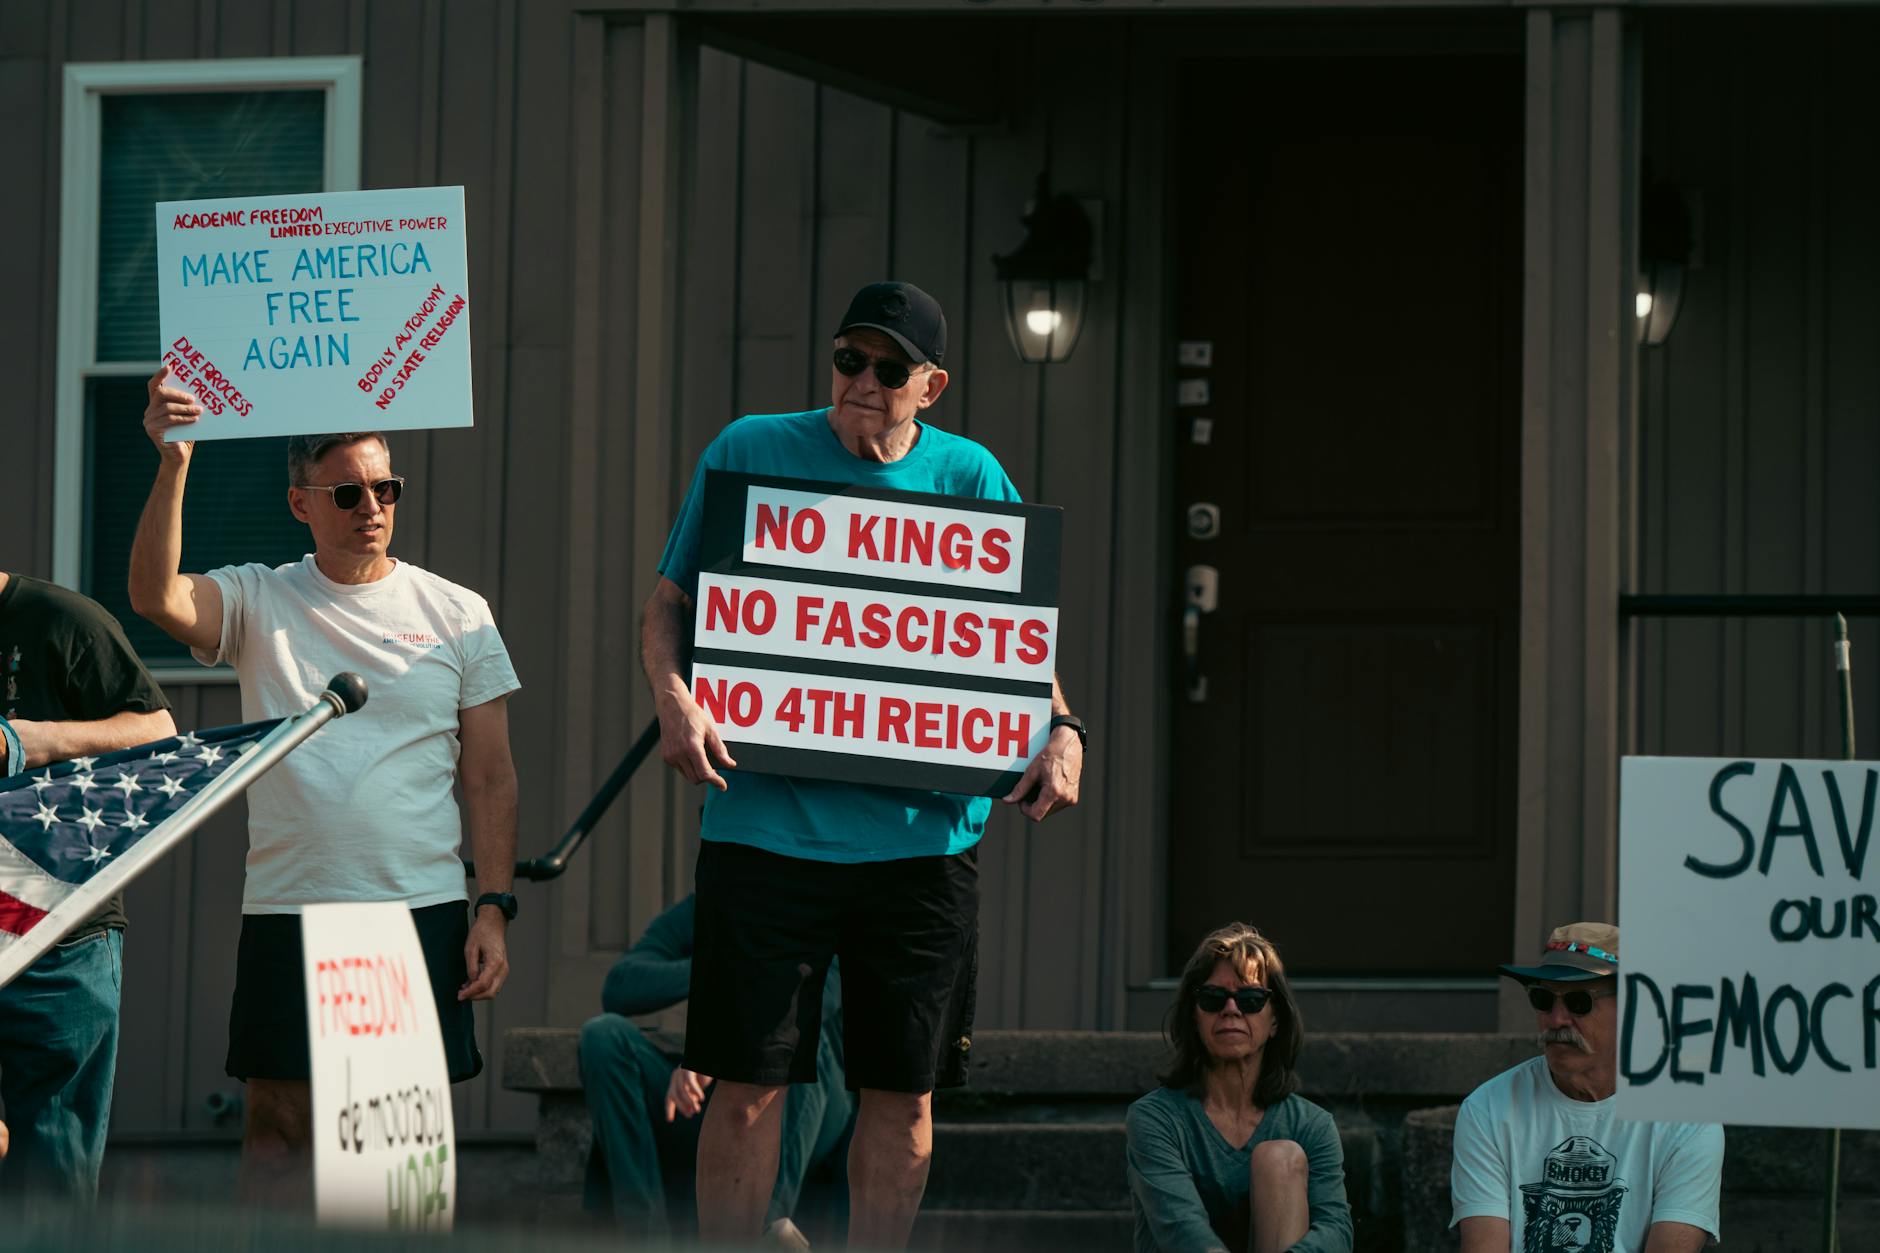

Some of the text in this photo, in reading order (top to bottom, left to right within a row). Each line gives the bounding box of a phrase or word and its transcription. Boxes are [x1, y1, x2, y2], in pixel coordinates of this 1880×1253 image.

[173, 206, 323, 231] ACADEMIC FREEDOM
[270, 216, 447, 239] LIMITED EXECUTIVE POWER
[182, 241, 432, 287] MAKE AMERICA
[266, 288, 360, 326] FREE
[357, 282, 447, 393] BODILY AUTONOMY
[162, 351, 227, 415] FREE PRESS
[172, 336, 254, 417] DUE PROCESS
[243, 333, 351, 371] AGAIN
[375, 293, 467, 410] NO STATE RELIGION
[755, 503, 1012, 574] NO KINGS
[705, 585, 1050, 666] NO FASCISTS
[695, 677, 1031, 759] NO 4TH REICH
[1769, 893, 1880, 943] OUR
[316, 954, 419, 1038] FREEDOM
[1547, 1160, 1610, 1182] SMOKEY
